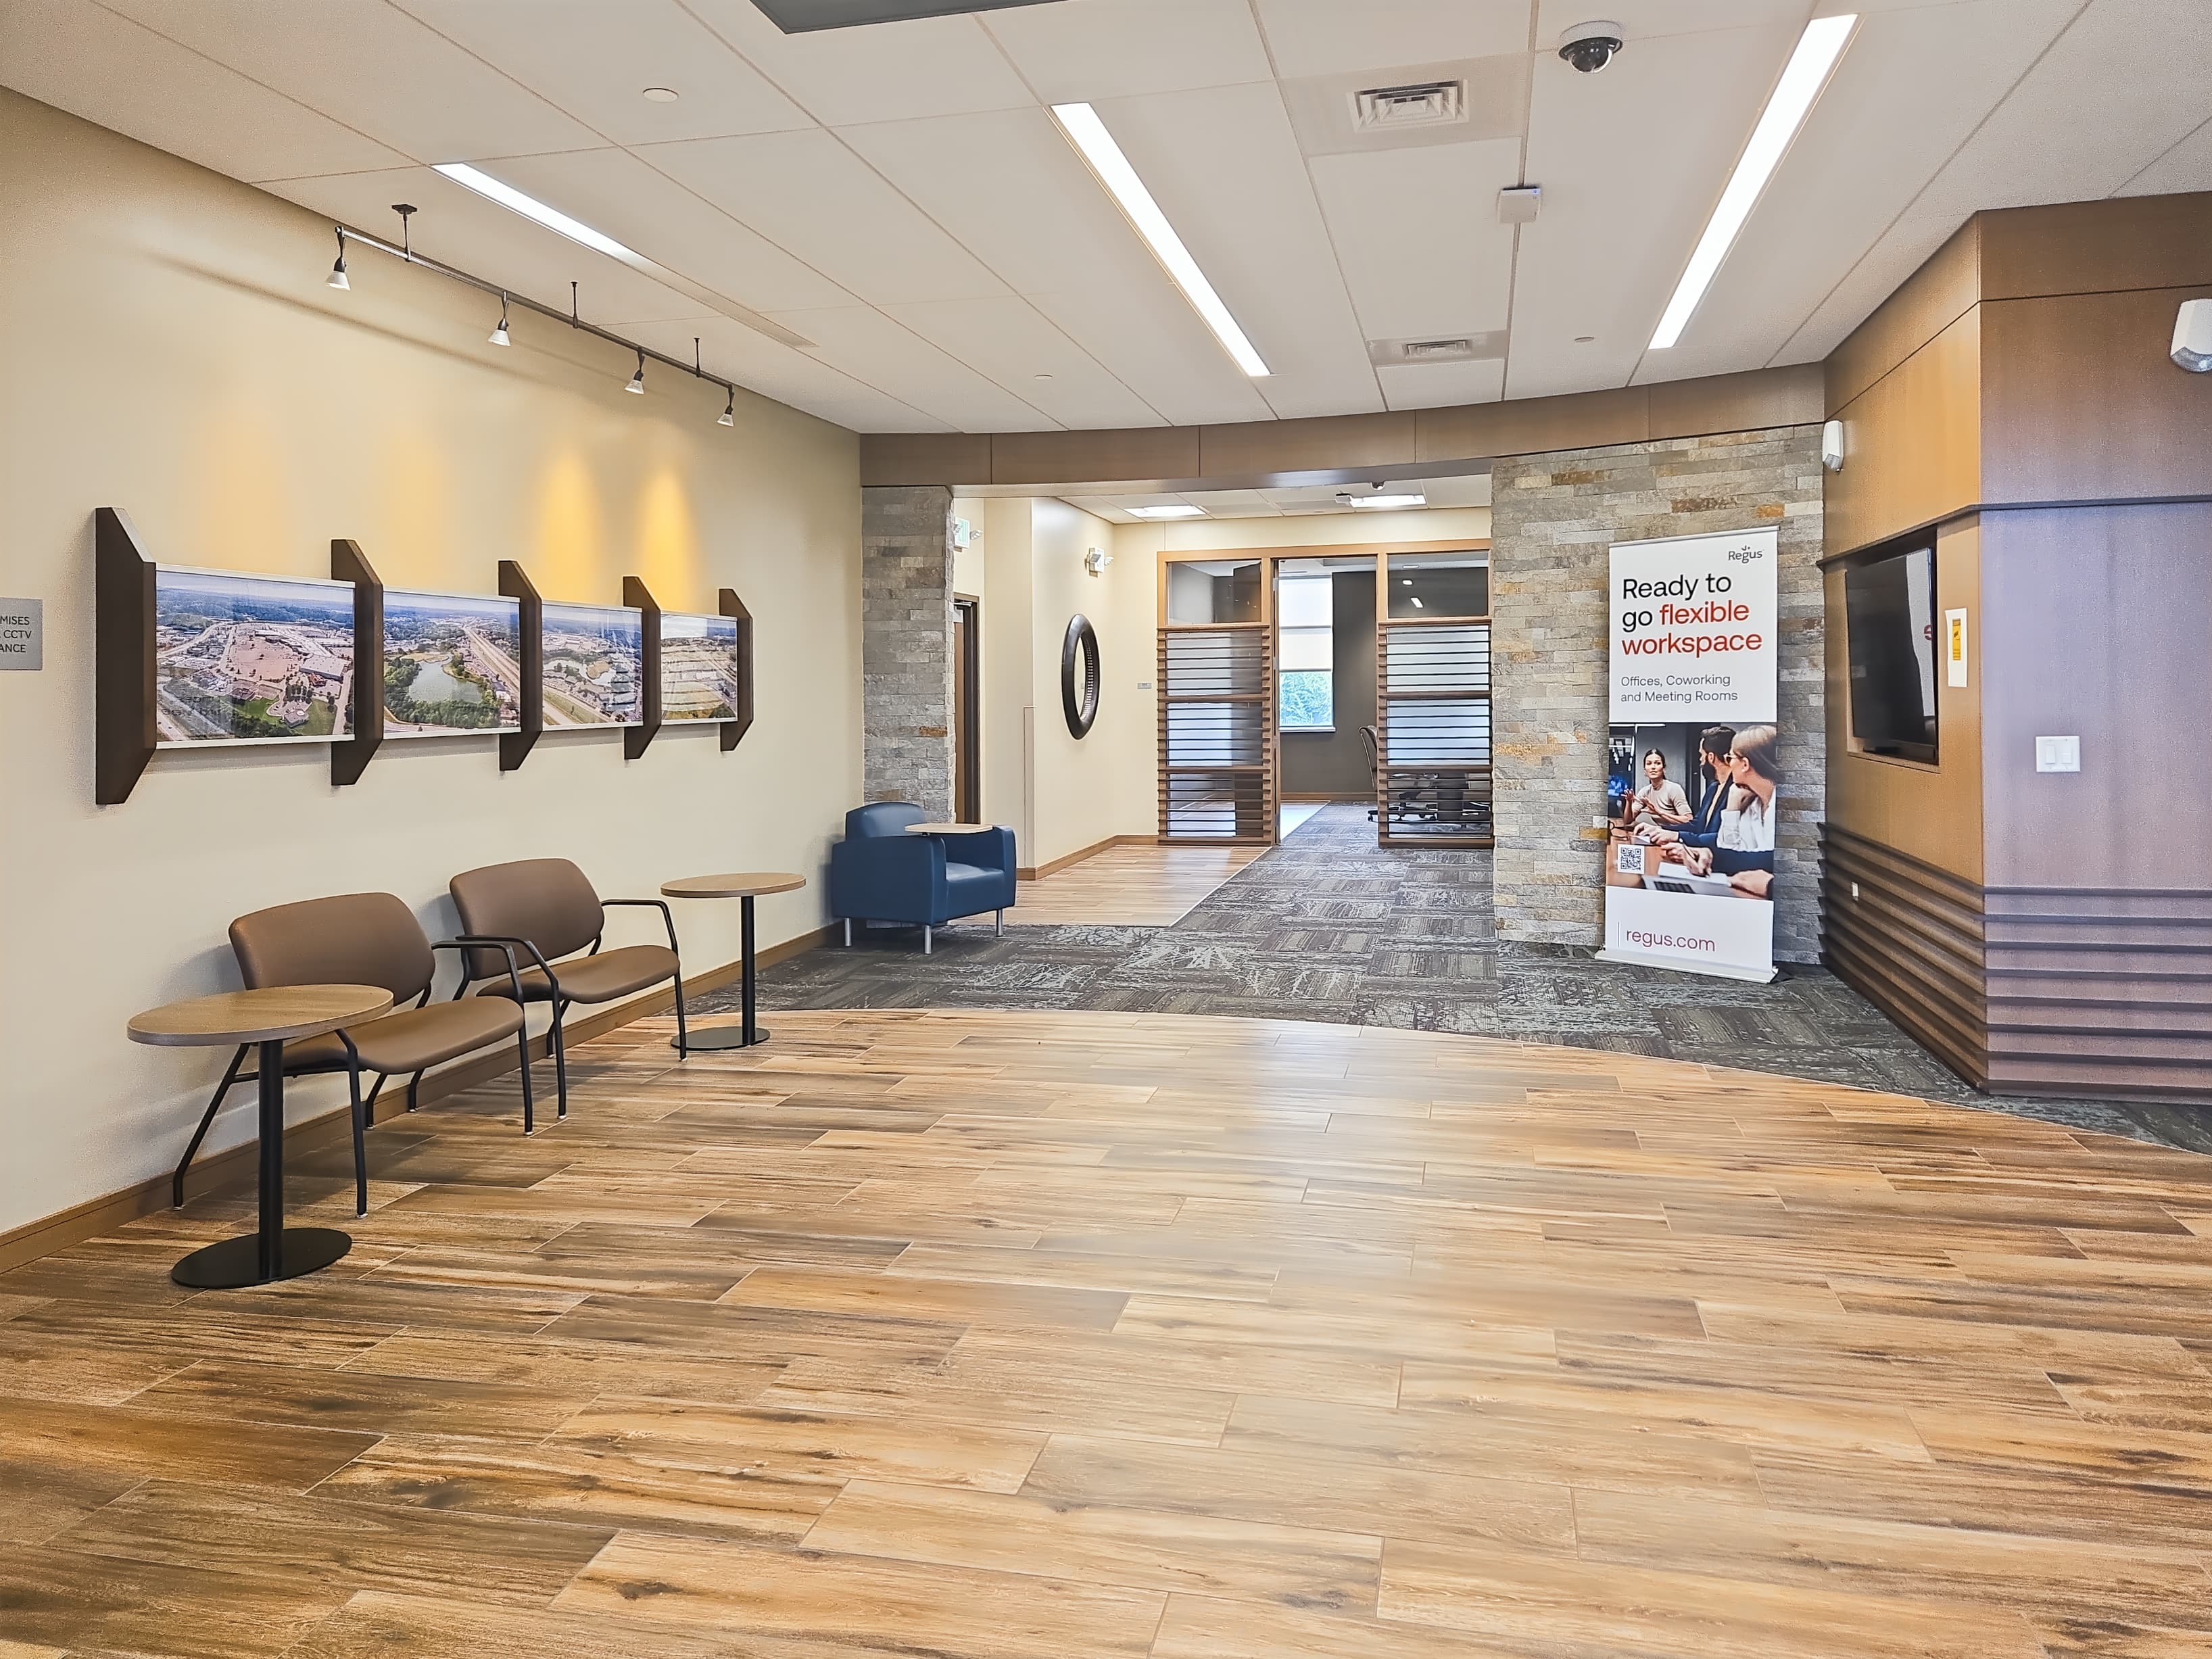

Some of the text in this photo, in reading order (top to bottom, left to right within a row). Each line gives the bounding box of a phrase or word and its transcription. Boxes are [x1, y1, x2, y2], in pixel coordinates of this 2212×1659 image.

[1728, 550, 1763, 564] Regus
[1622, 573, 1731, 600] Ready to
[0, 615, 30, 625] MISES
[1622, 600, 1750, 633] go flexible
[3, 629, 32, 639] CCTV
[1621, 633, 1762, 658] workspace
[1620, 674, 1731, 688] Offices, Coworking
[1620, 690, 1738, 704] and Meeting Rooms
[1626, 930, 1716, 952] regus.com
